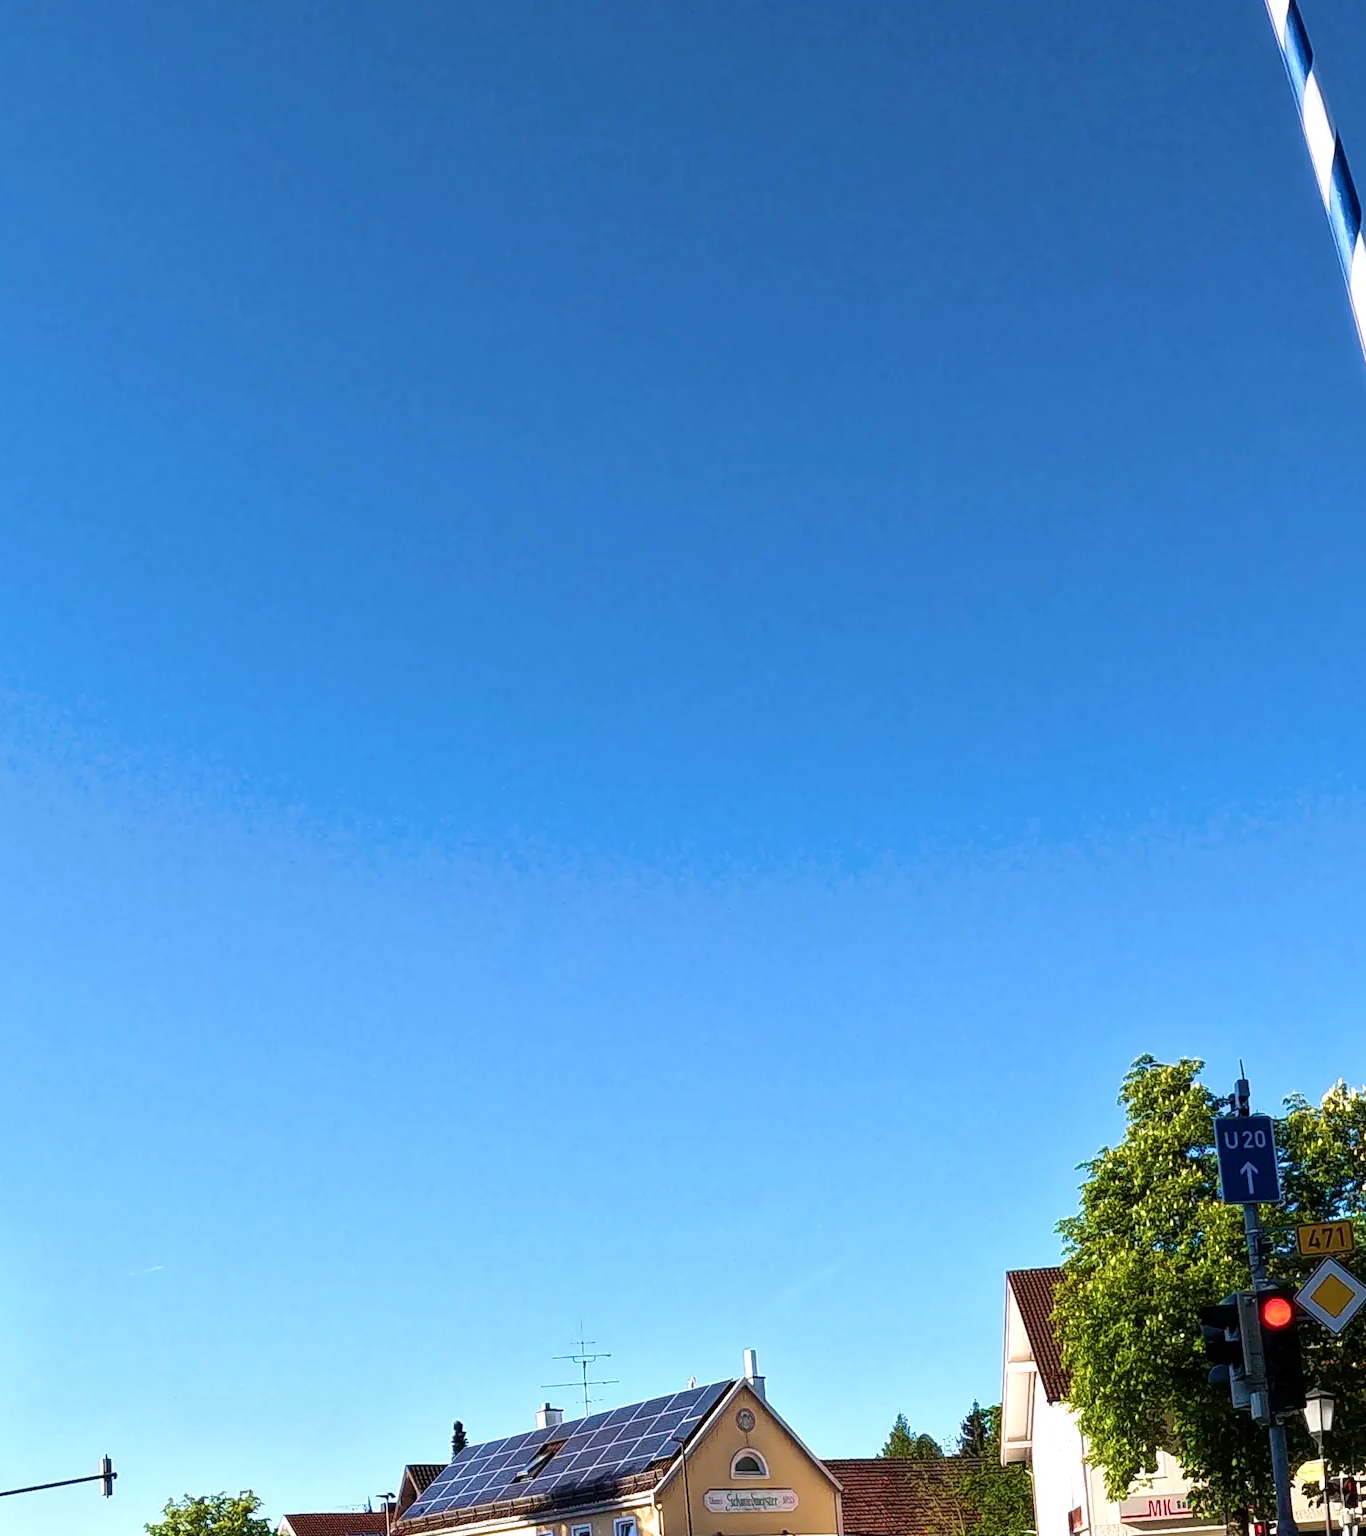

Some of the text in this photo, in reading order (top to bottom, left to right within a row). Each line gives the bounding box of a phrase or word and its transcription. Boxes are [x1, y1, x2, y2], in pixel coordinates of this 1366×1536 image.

[1224, 1130, 1266, 1149] U 20
[1308, 1227, 1346, 1250] 471
[1148, 1499, 1171, 1517] MK
